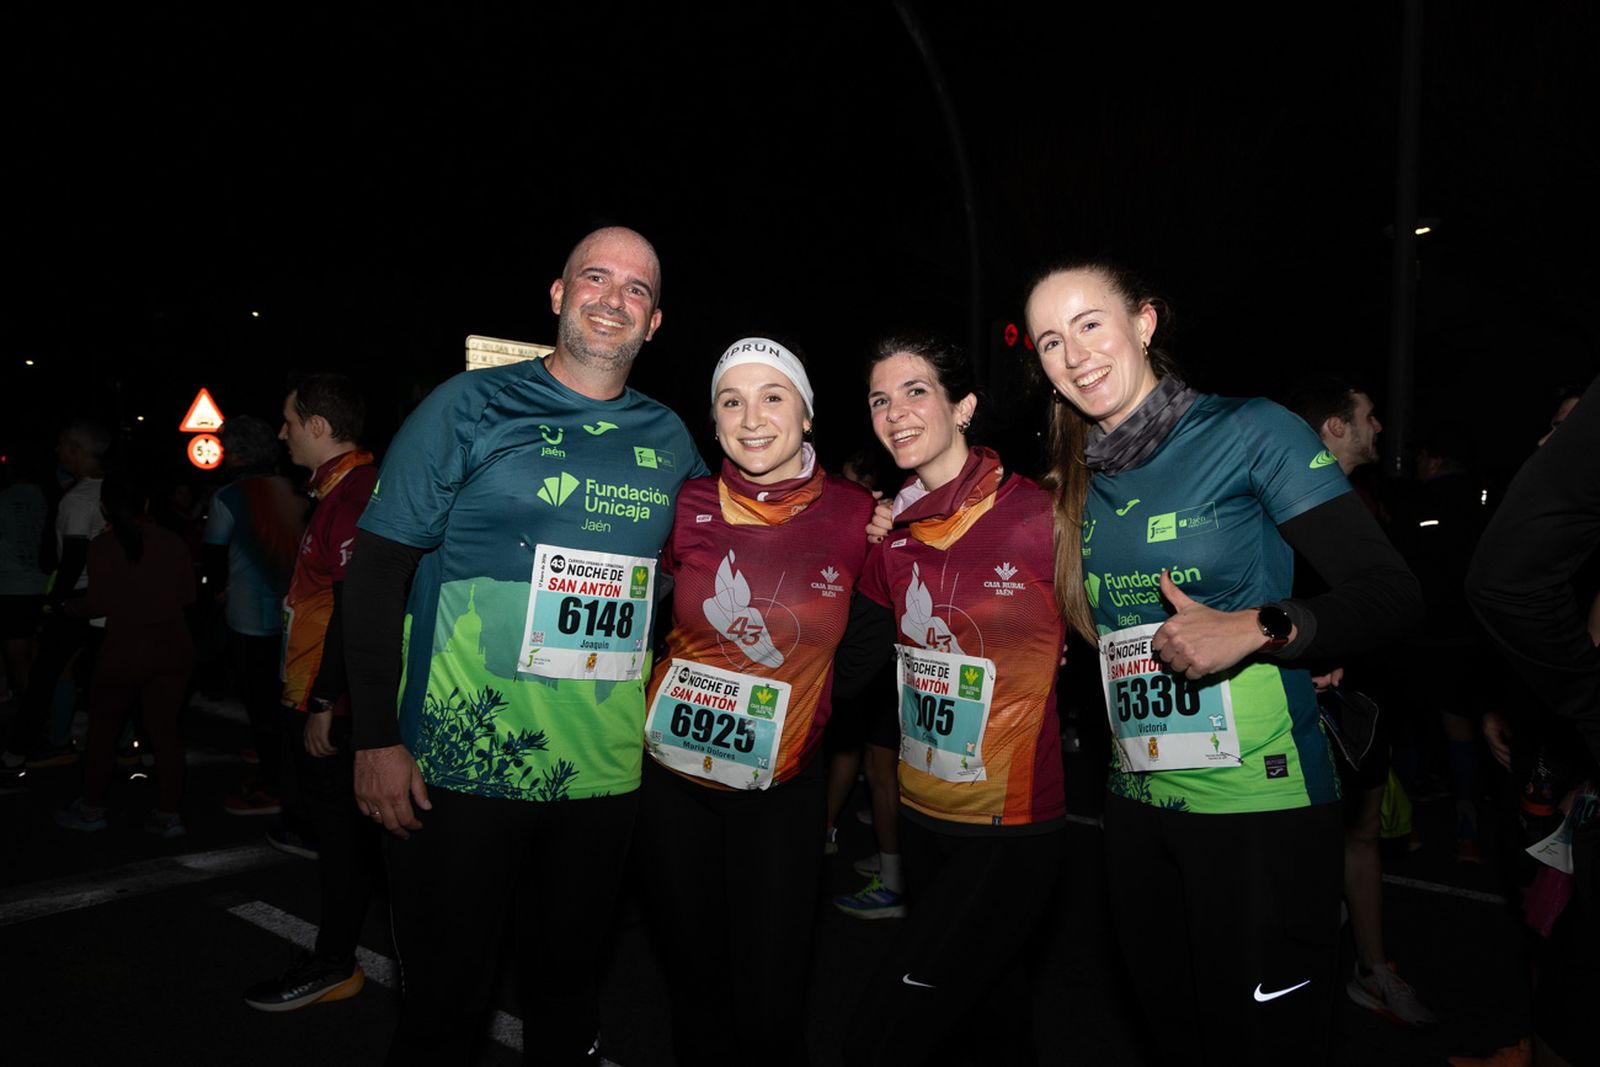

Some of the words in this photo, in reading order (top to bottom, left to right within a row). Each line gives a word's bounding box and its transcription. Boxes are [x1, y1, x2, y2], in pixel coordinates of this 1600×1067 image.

[586, 478, 670, 506] Fundación
[584, 495, 650, 523] Unicaja
[581, 518, 612, 533] Jaén
[551, 558, 565, 571] 43
[567, 564, 609, 580] NOCHE
[609, 569, 625, 581] DE
[548, 577, 578, 593] SAN
[579, 581, 622, 598] ANTÓN
[984, 581, 1001, 589] CAJA
[1002, 582, 1026, 590] RURAL
[1104, 566, 1202, 590] Fundacón
[1109, 589, 1164, 608] Unicaj
[558, 596, 635, 639] 6148
[726, 616, 763, 646] 43
[1116, 641, 1148, 660] NOCHE
[912, 662, 936, 677] OCHE
[937, 666, 950, 679] DE
[688, 674, 722, 694] NOCHE
[723, 684, 740, 697] DE
[916, 678, 949, 696] ANTÓN
[670, 686, 692, 702] SAN
[693, 695, 737, 712] ANTÓN
[670, 703, 757, 753] 6925
[1138, 721, 1168, 734] Victoria
[706, 746, 736, 761] Dolores
